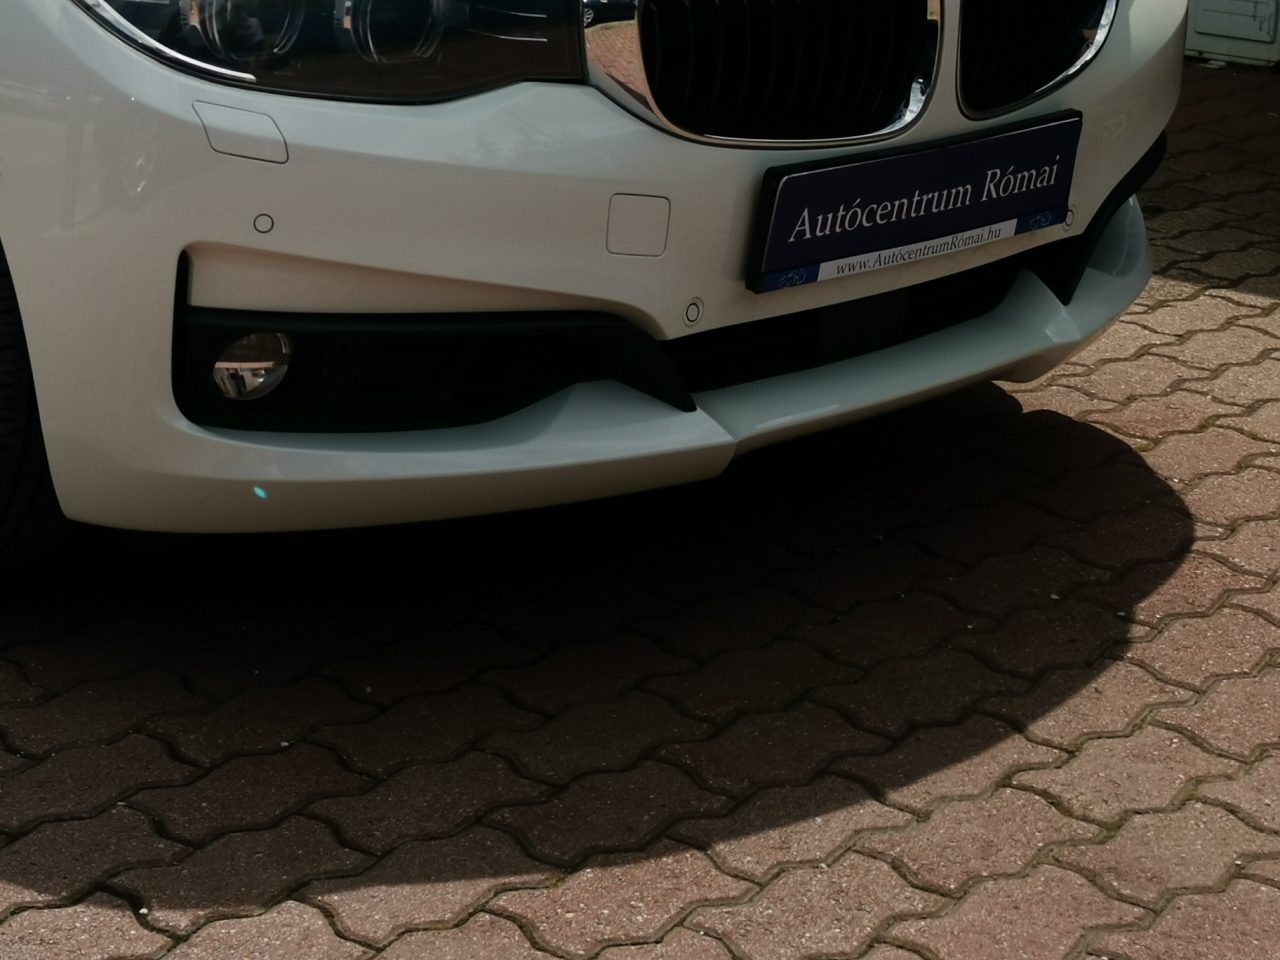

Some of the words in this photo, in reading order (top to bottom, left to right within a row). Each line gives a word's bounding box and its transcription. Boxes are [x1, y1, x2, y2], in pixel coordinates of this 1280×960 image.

[788, 184, 972, 243] Autócentrum
[981, 154, 1061, 203] Római
[835, 226, 1001, 275] www.AutócentrumRómai.hu
